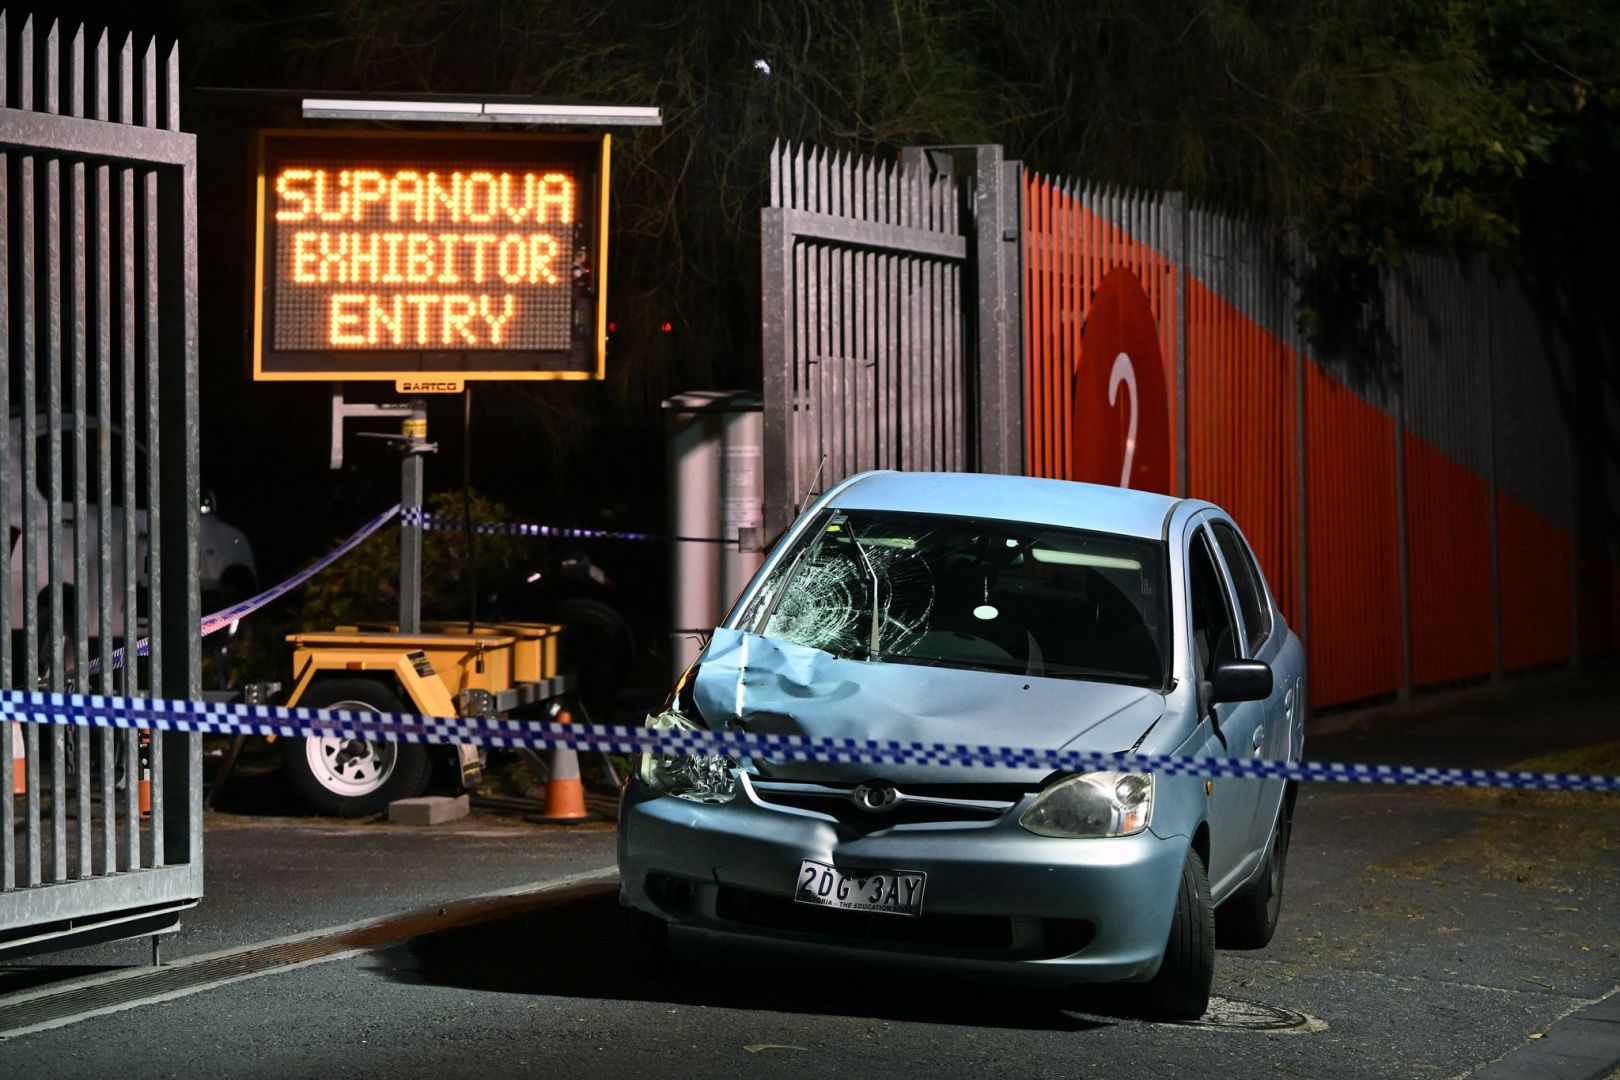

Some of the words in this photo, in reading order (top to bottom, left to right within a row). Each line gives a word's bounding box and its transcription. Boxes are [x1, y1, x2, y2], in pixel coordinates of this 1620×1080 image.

[275, 169, 573, 224] SUPANOVA
[293, 232, 559, 284] EXHIBITOR
[329, 293, 515, 345] ENTRY
[403, 382, 457, 391] BARTCO
[869, 876, 922, 907] 3AY
